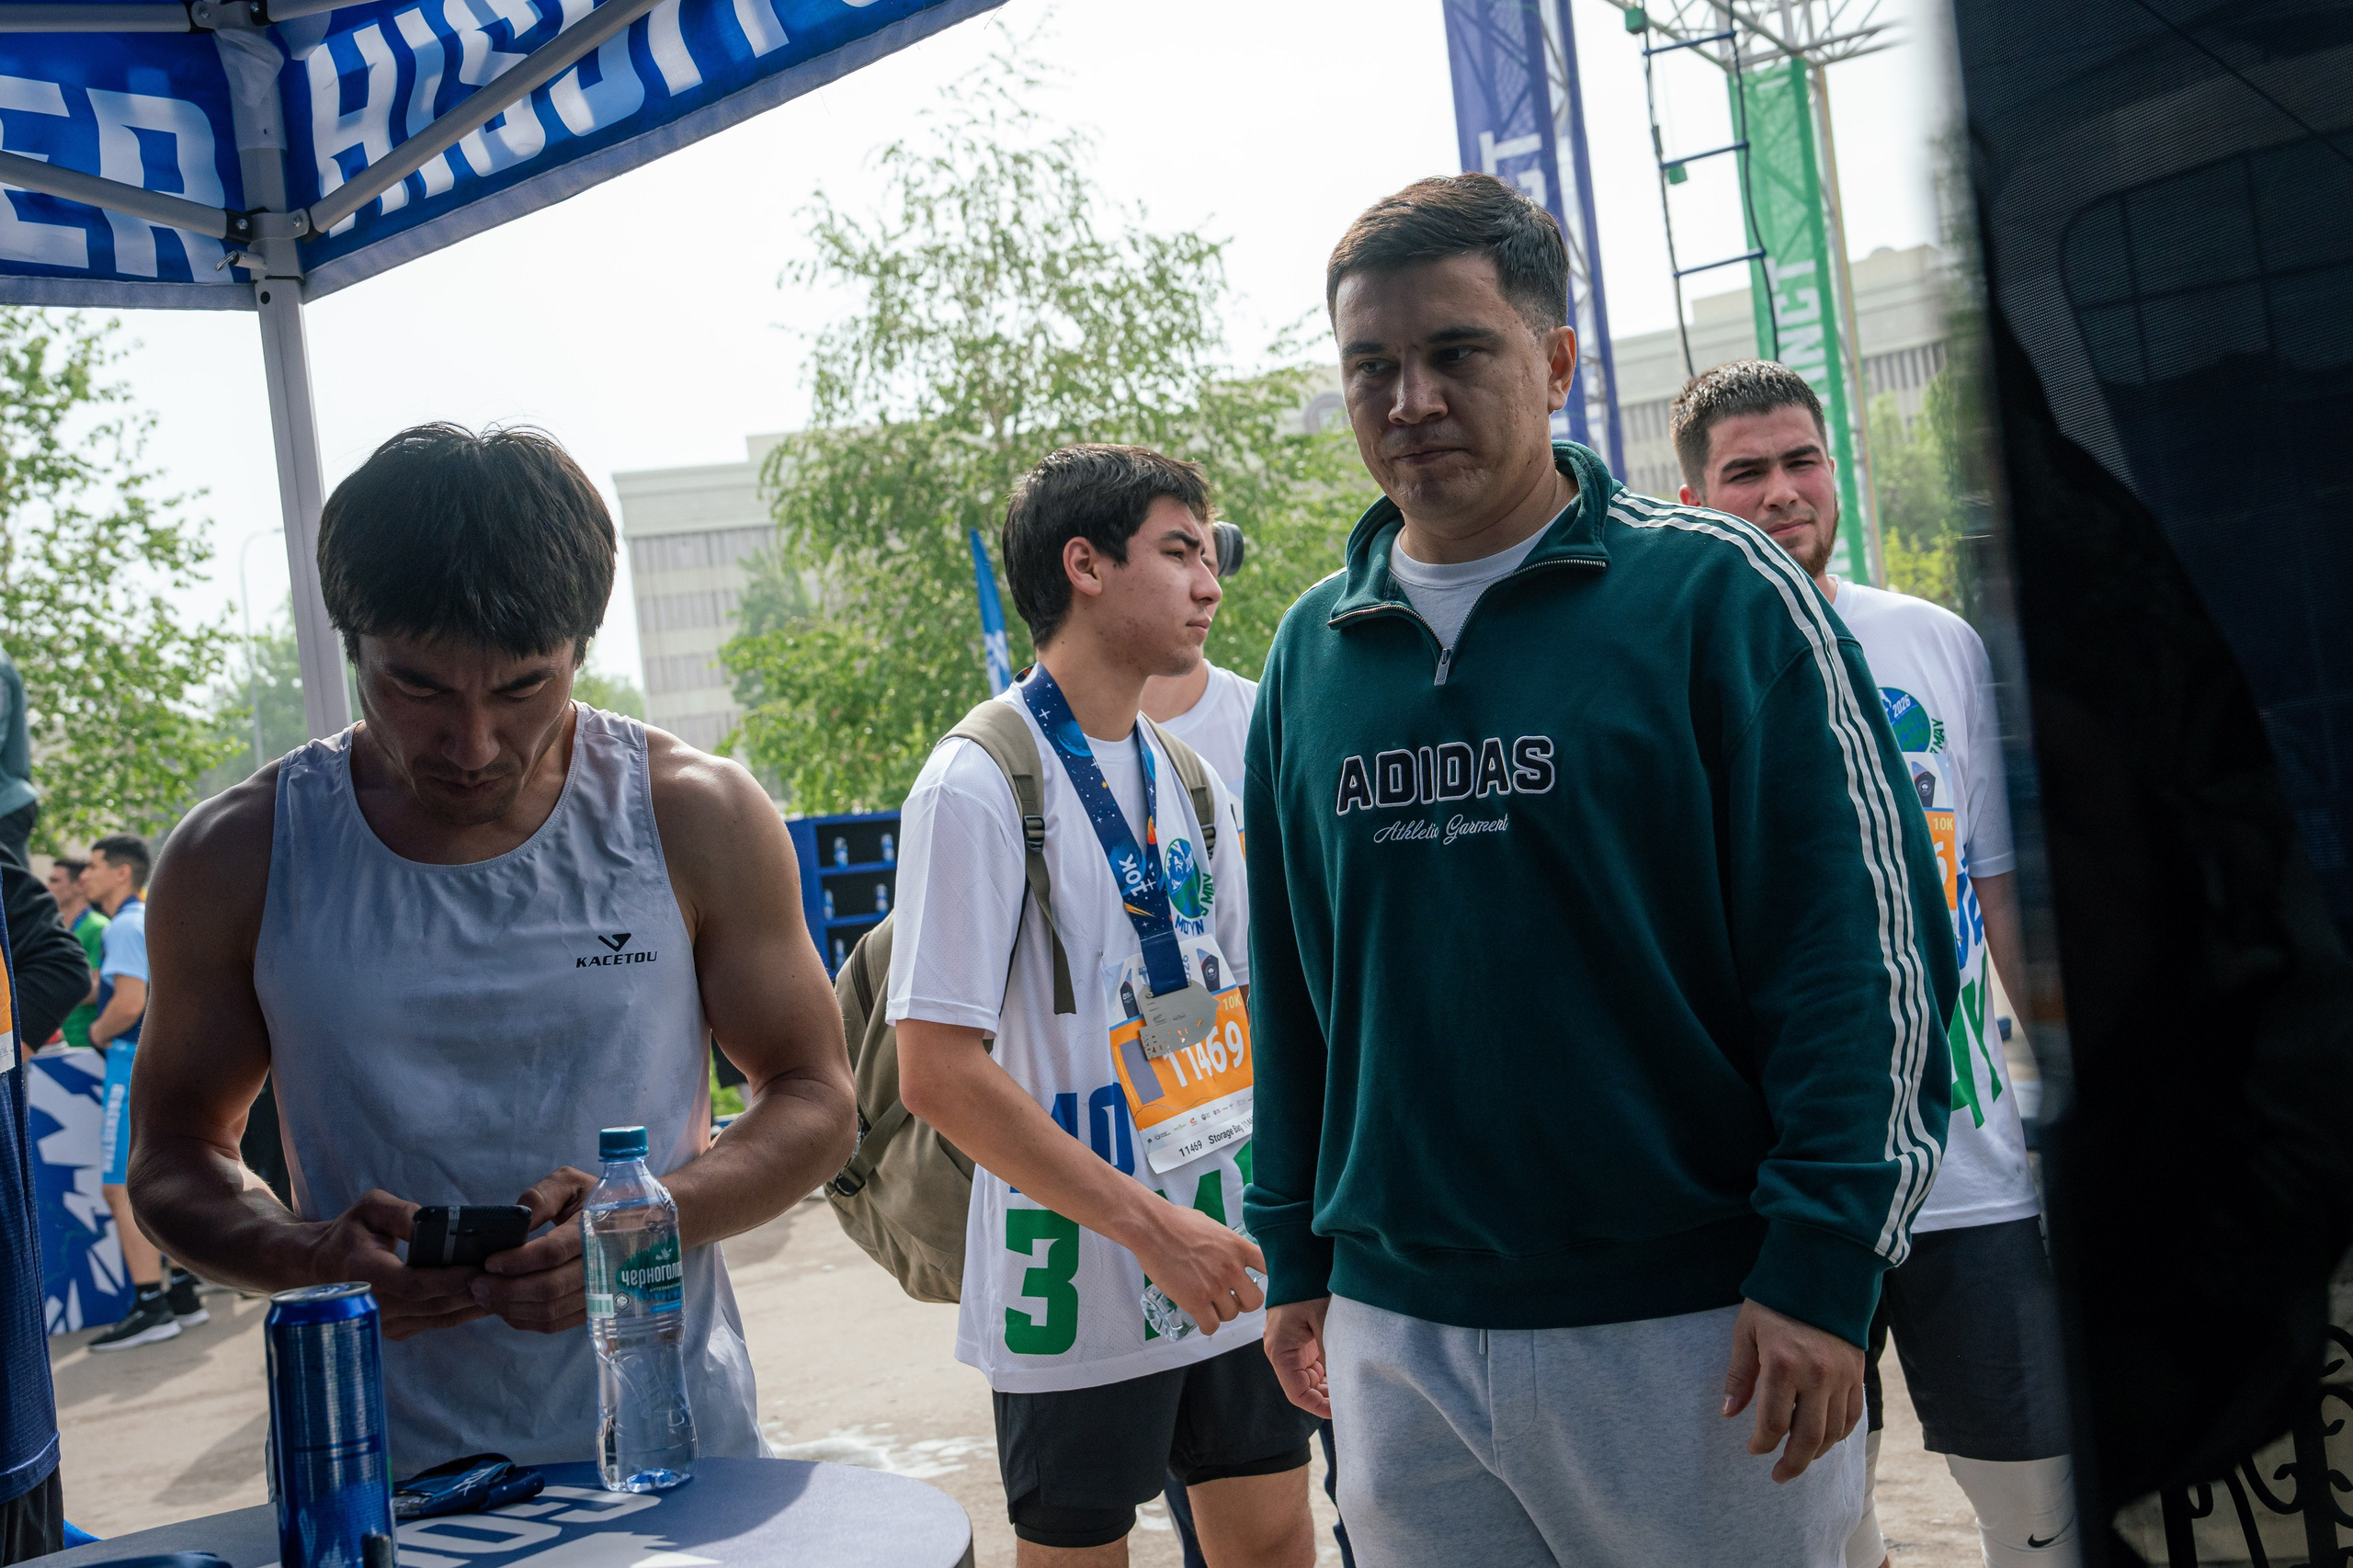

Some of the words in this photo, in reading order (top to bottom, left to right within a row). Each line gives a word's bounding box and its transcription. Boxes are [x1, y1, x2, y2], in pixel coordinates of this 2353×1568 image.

[1336, 735, 1556, 816] ADIDAS
[1373, 820, 1440, 843] Athletic
[1442, 813, 1509, 845] Garment
[1933, 817, 1954, 831] 10K
[1118, 853, 1149, 897] 10K
[575, 950, 658, 968] KACETOU
[1222, 994, 1242, 1011] 10K
[1163, 1020, 1245, 1087] 11469
[1178, 1140, 1203, 1157] 11469
[1208, 1128, 1234, 1145] Storage
[1005, 1209, 1079, 1355] 3
